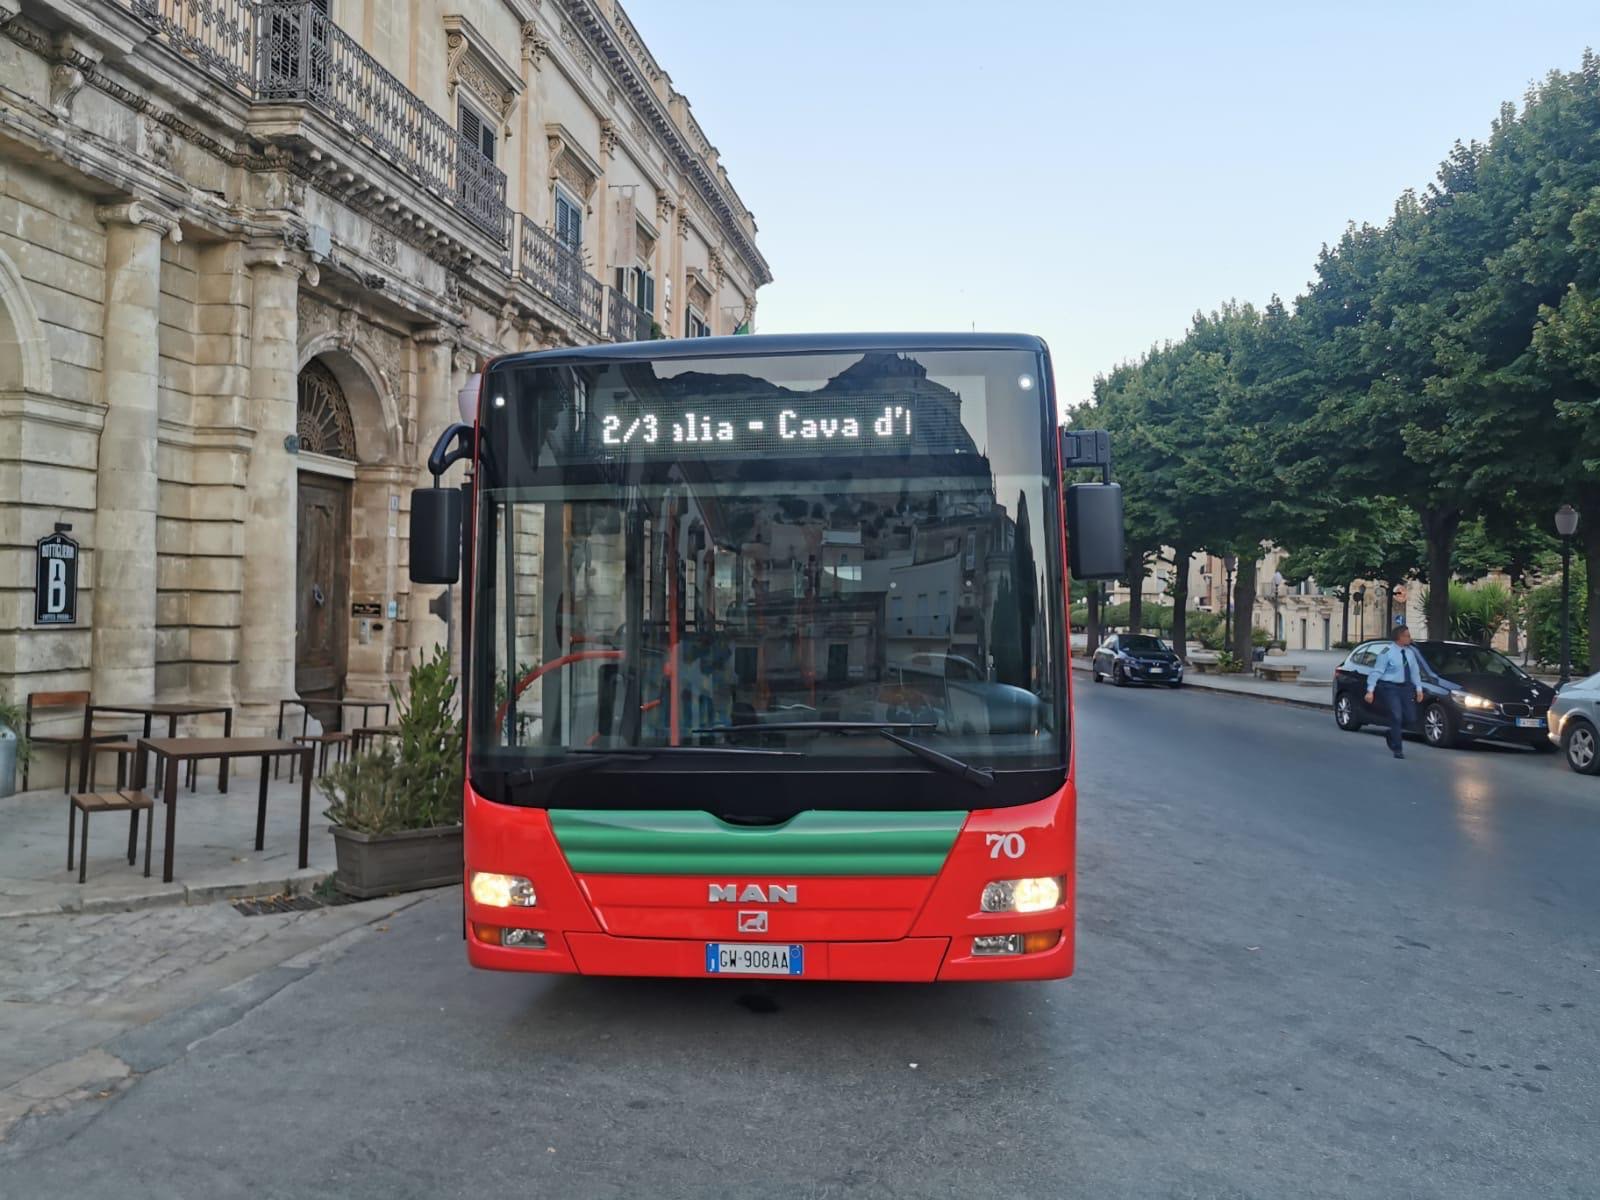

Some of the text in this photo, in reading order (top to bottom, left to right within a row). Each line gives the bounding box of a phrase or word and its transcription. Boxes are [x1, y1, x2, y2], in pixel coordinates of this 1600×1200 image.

[602, 414, 658, 444] 2/3
[778, 409, 859, 439] Cava
[47, 558, 66, 613] B
[985, 832, 1026, 859] 70
[708, 883, 798, 903] MAN
